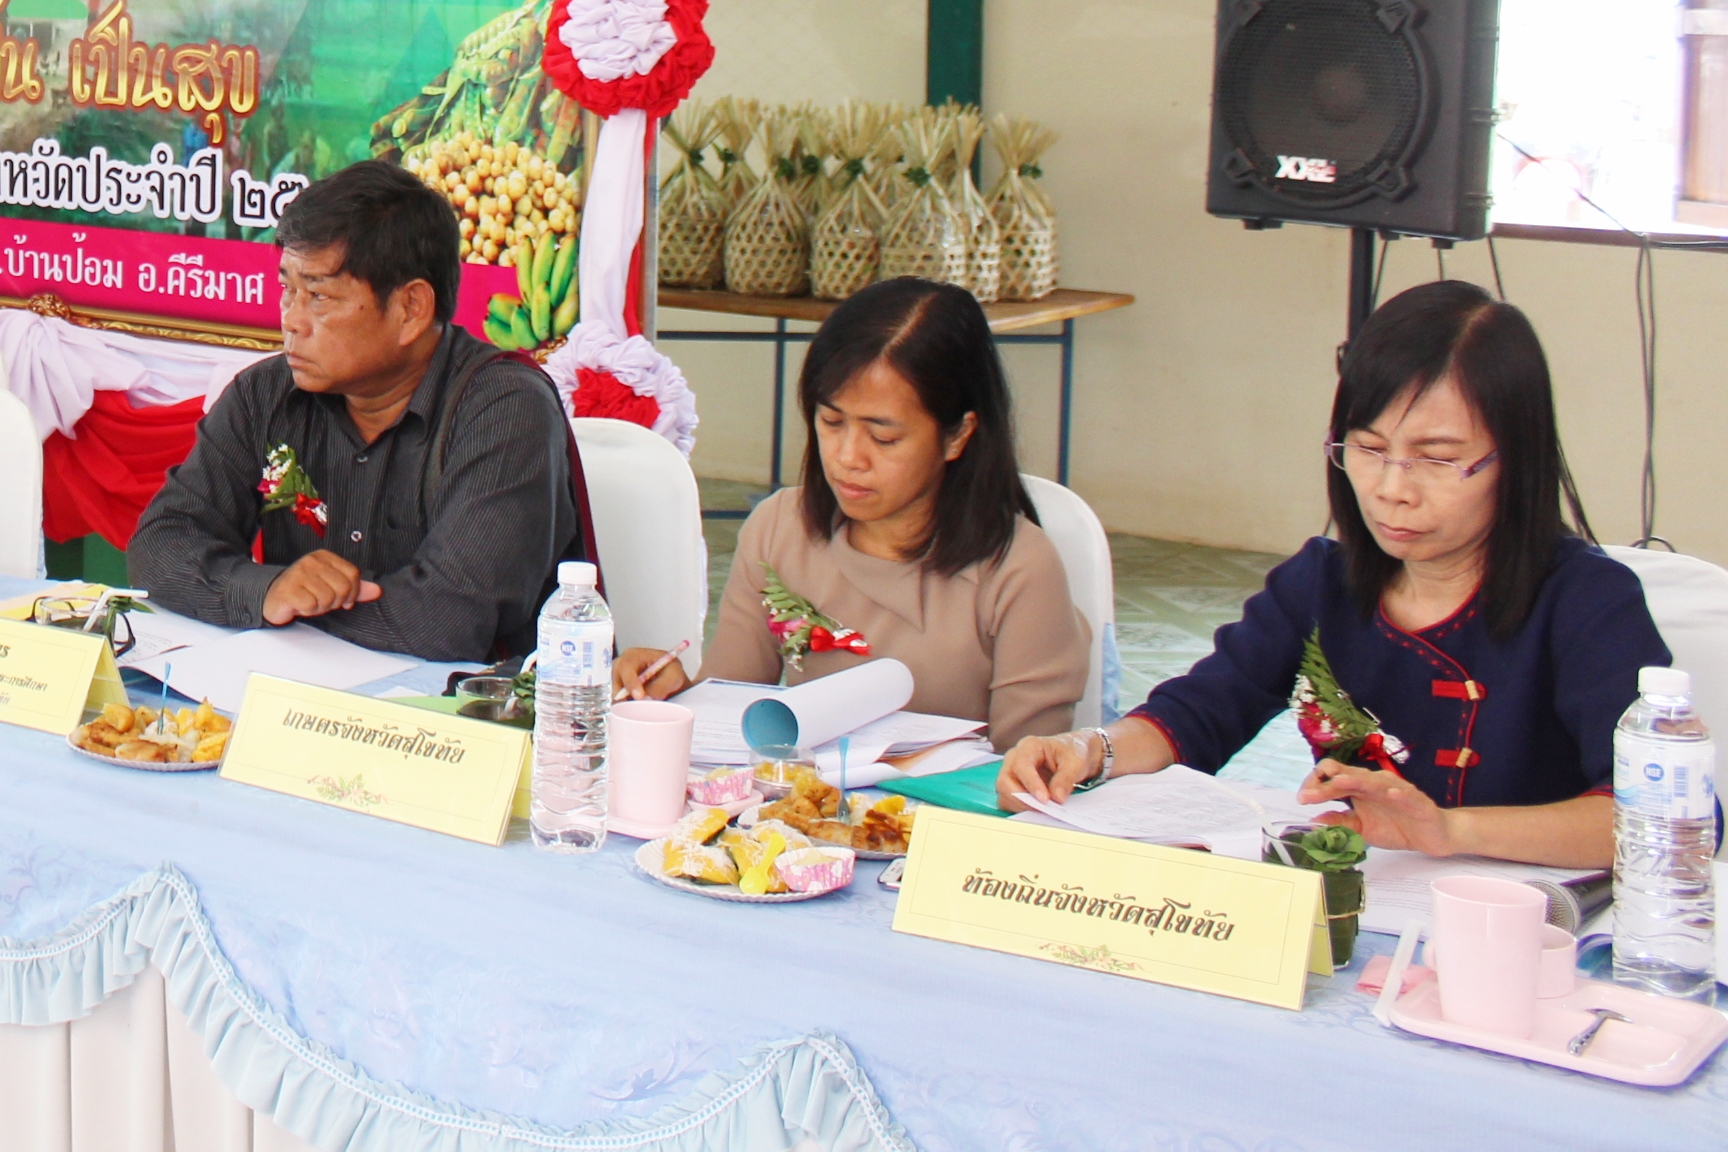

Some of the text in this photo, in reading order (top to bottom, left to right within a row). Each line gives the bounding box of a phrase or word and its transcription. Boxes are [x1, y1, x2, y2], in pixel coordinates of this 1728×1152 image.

[138, 253, 265, 306] อ.คีรีมาศ
[282, 708, 466, 764] เกษตรจังหวัดสุโขทัย
[960, 867, 1235, 942] ท้องถิ่นจังหวัดสุโขทัย
